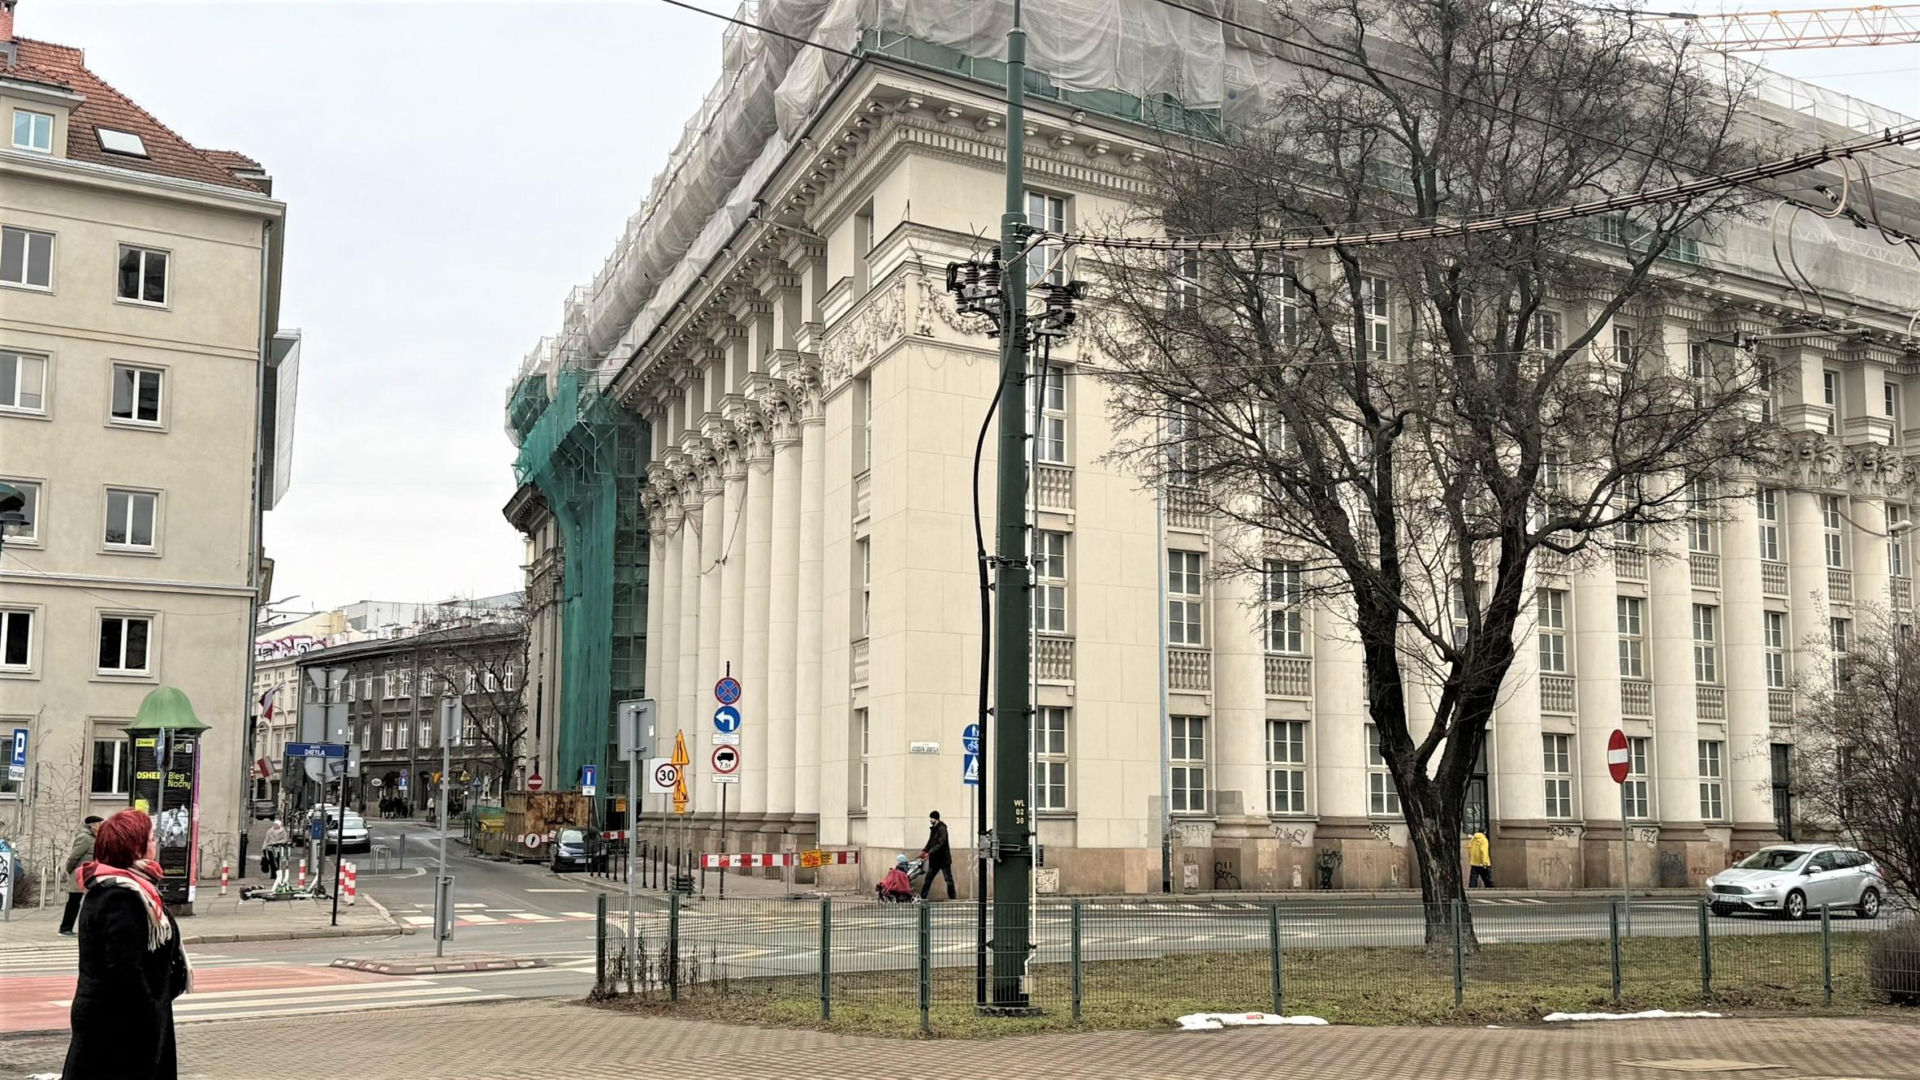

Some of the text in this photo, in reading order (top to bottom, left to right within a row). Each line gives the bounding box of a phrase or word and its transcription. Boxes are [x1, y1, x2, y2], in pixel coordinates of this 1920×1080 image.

[14, 732, 26, 761] P
[168, 771, 185, 782] Bieg
[658, 769, 675, 782] 30
[167, 780, 191, 790] Nocny
[1013, 799, 1025, 807] WL
[1015, 808, 1025, 816] 02
